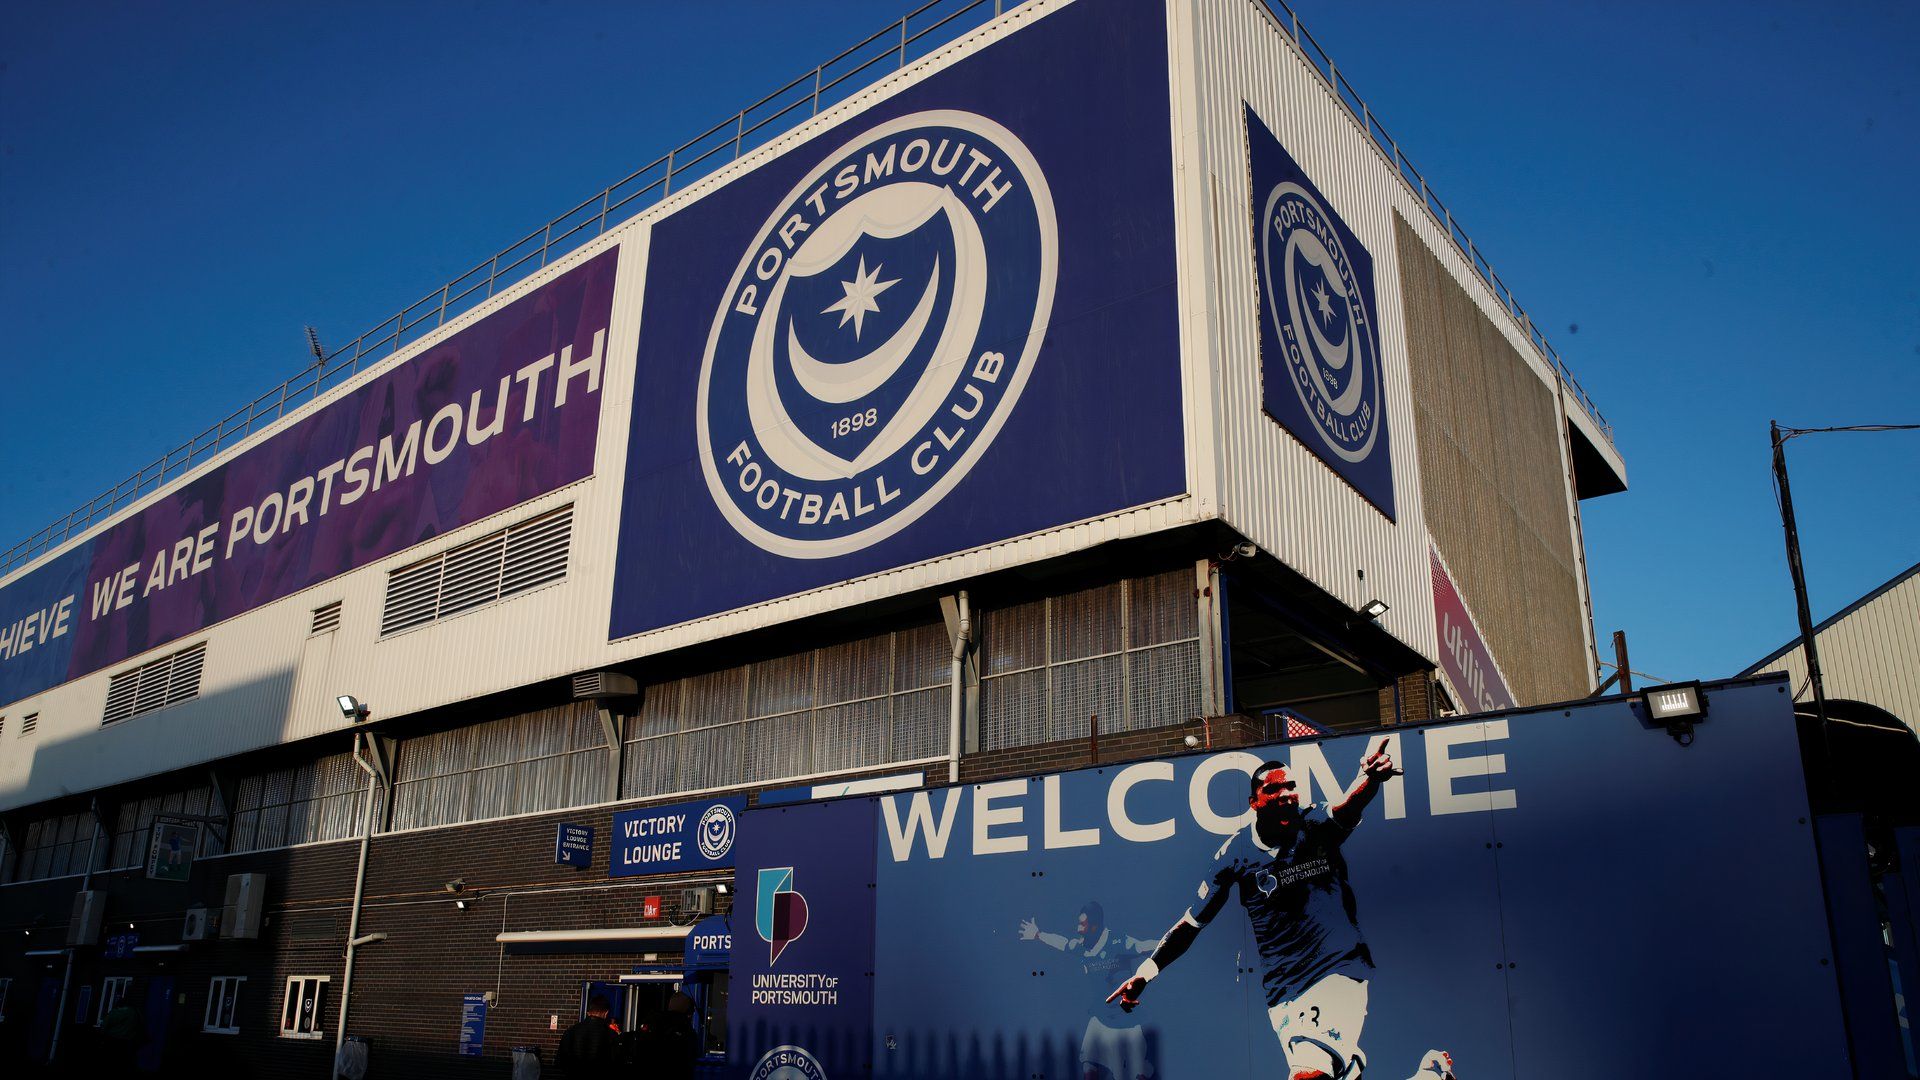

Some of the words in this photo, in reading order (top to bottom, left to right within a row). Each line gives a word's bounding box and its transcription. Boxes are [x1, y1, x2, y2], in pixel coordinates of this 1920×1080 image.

[735, 138, 1013, 316] PORTSMOUTH
[1273, 200, 1364, 325] PORTSMOUTH
[1283, 324, 1349, 442] FOOTBALL
[1349, 400, 1372, 442] CLUB
[726, 440, 901, 525] FOOTBALL
[911, 350, 1005, 476] CLUB
[831, 408, 878, 439] 1898
[92, 562, 140, 621] WE
[143, 522, 220, 598] ARE
[225, 327, 607, 560] PORTSMOUTH
[879, 719, 1518, 863] WELCOME
[624, 814, 686, 838] VICTORY
[624, 842, 682, 865] LOUNGE
[1280, 860, 1320, 878] UNIVERSITY
[1281, 864, 1331, 886] PORTSMOUTH
[752, 974, 826, 988] UNIVERSITY
[826, 977, 839, 988] OF
[752, 990, 838, 1005] PORTSMOUTH
